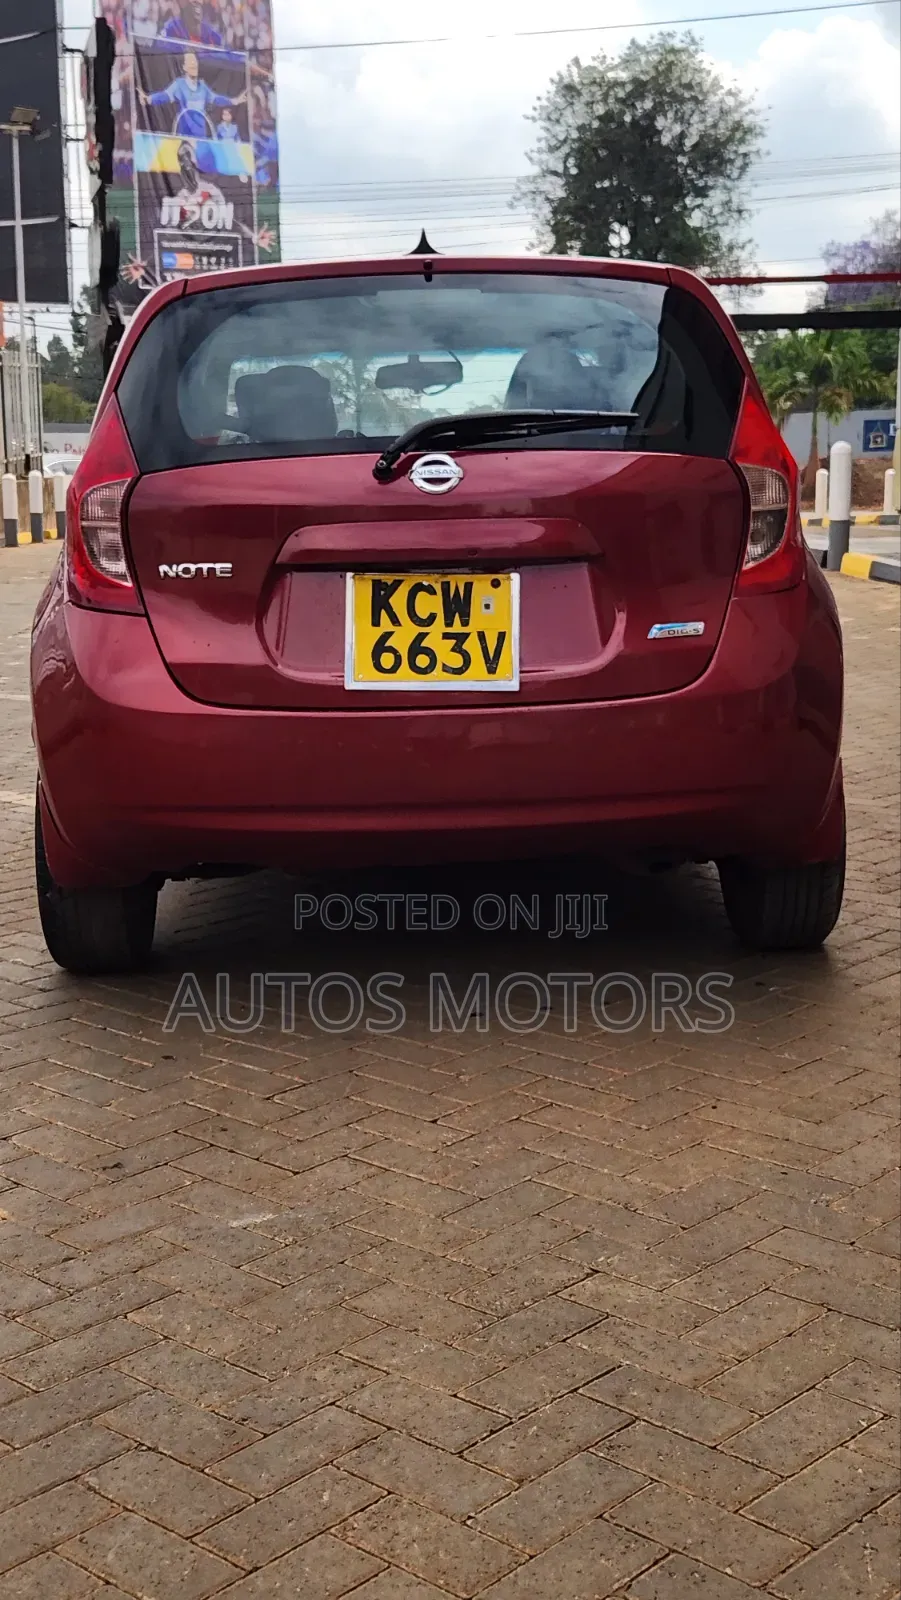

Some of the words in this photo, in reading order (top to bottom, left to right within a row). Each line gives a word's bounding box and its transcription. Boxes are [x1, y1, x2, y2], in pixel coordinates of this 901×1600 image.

[158, 562, 233, 579] NOTE
[371, 579, 474, 628] KCW
[371, 631, 507, 676] 663V
